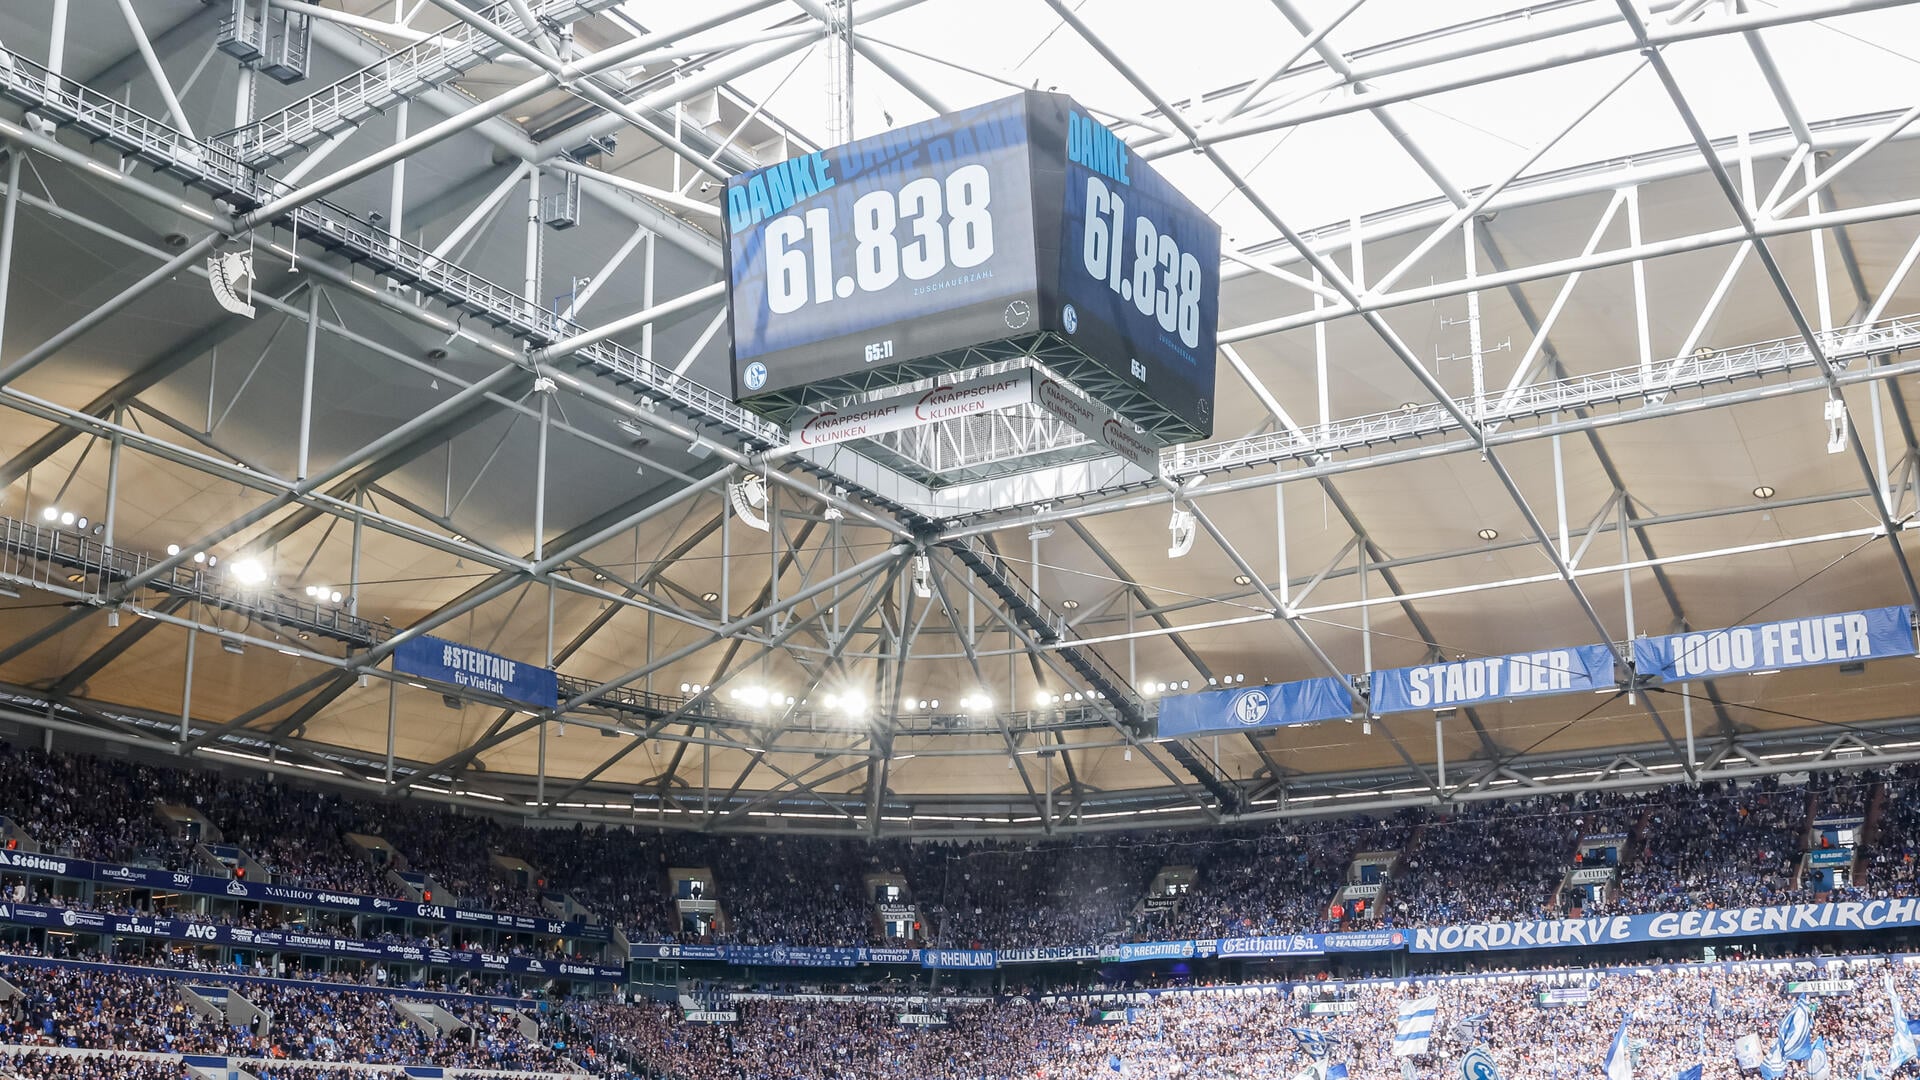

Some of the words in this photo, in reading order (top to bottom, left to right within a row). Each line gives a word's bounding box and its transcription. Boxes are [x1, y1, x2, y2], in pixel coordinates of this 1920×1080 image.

[1069, 109, 1130, 186] DANKE
[728, 151, 836, 234] DANKE
[765, 164, 994, 314] 61.838
[1084, 176, 1201, 349] 61.838
[914, 270, 994, 297] ZUSCHAUERZAHL
[865, 340, 893, 362] 65:11
[930, 379, 1020, 406] KNAPPSCHAFT
[930, 401, 985, 420] KLINIKEN
[1046, 387, 1095, 424] KNAPPSCHAFT
[1047, 402, 1077, 425] KLINIKEN
[815, 405, 899, 431] KNAPPSCHAFT
[814, 426, 867, 444] KLINIKEN
[1110, 427, 1154, 459] KNAPPSCHAFT
[1110, 441, 1139, 462] KLINIKEN
[1671, 628, 1755, 677] 1000
[1761, 614, 1871, 666] FEUER
[443, 645, 516, 683] #STEHTAUF
[455, 671, 469, 685] für
[470, 676, 504, 695] Vielfalt
[1410, 659, 1503, 707] STADT
[1509, 651, 1571, 693] DER
[12, 854, 66, 874] Stölting
[173, 874, 190, 883] SDK
[265, 887, 313, 900] NAVAHOO
[326, 895, 360, 905] POLYGON
[116, 923, 133, 932] ESA
[134, 924, 152, 934] BAU
[185, 924, 217, 940] AVG
[548, 922, 562, 933] bfs
[1415, 916, 1632, 951] NORDKURVE
[1038, 945, 1099, 959] ENNEPETAL
[1133, 944, 1180, 957] KRECHTING
[1336, 939, 1390, 947] HAMBURG
[481, 954, 509, 964] SUN
[941, 952, 993, 966] RHEINLAND
[1810, 981, 1849, 991] VELTINS
[700, 1012, 731, 1020] VELTINS
